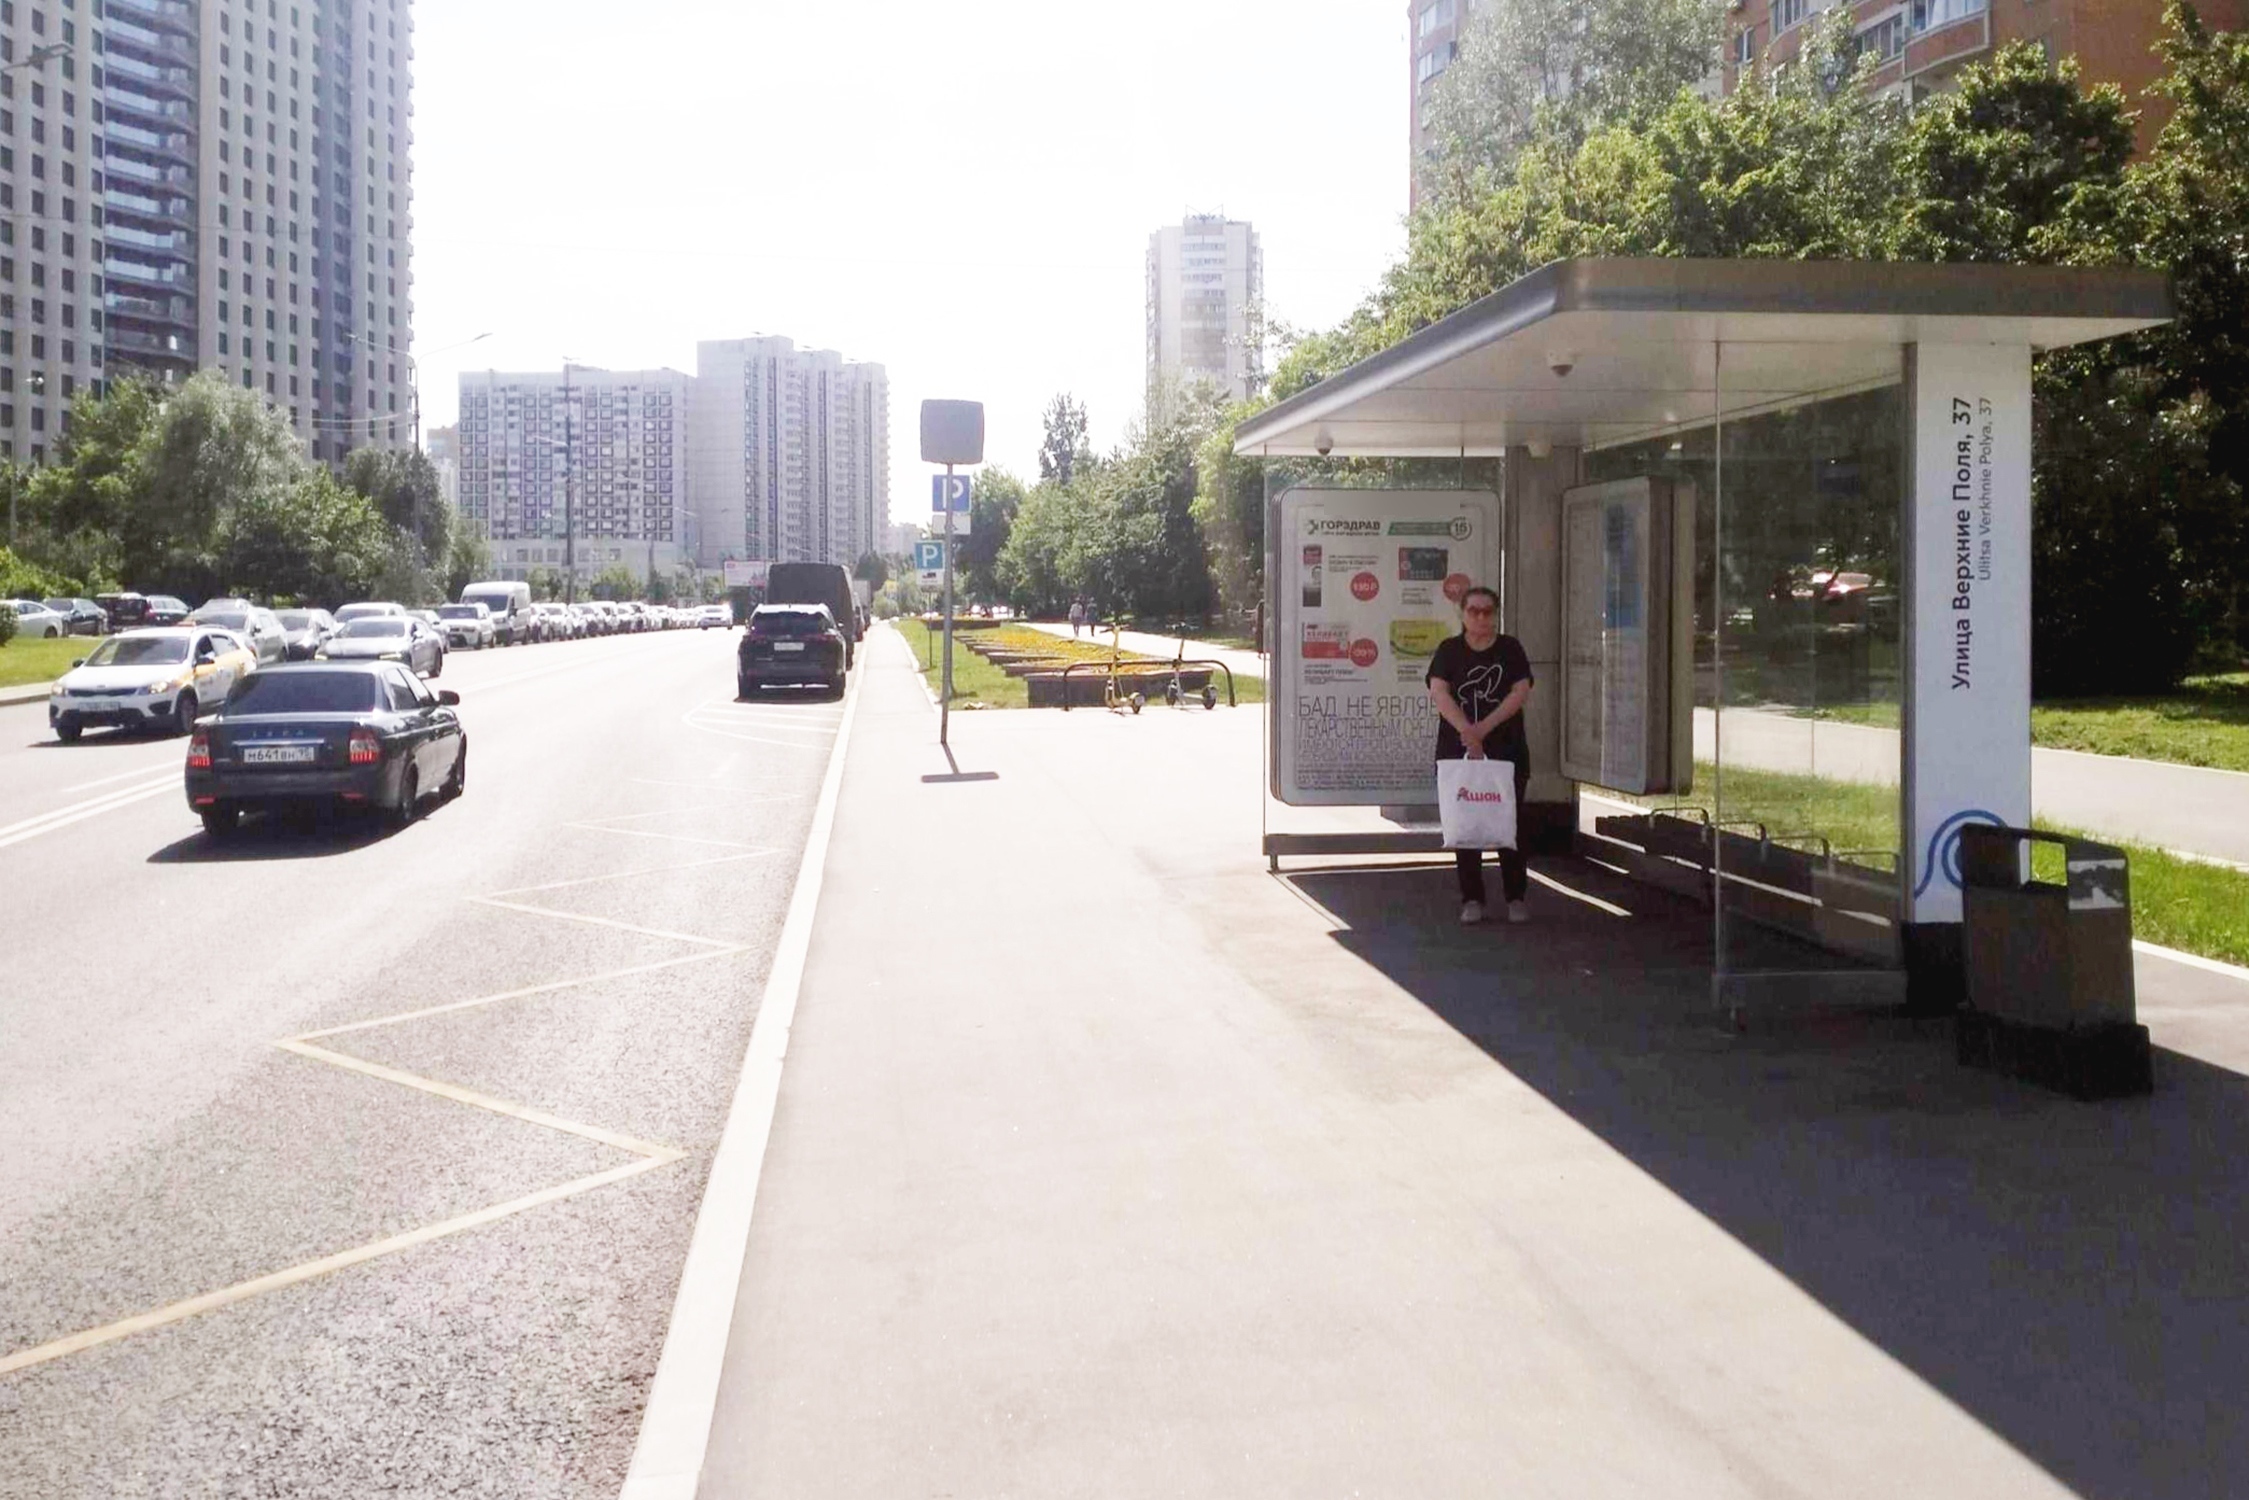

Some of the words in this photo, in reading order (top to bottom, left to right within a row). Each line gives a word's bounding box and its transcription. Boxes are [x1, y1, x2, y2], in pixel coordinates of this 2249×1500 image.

[1952, 397, 1972, 425] 37
[1979, 397, 1992, 415] 37
[1979, 421, 1994, 465] Polya,
[1952, 434, 1974, 501] Поля,
[942, 477, 964, 509] P
[1979, 468, 1992, 535] Verkhnie
[1320, 519, 1381, 531] ГОРЗДРАВ
[922, 543, 939, 568] P
[1952, 509, 1975, 610] Верхние
[1978, 539, 1992, 582] Ulitsa
[1952, 617, 1974, 691] Улица
[1346, 695, 1372, 717] НЕ
[1298, 717, 1401, 738] ЛЕКАРСТВЕННЫМ
